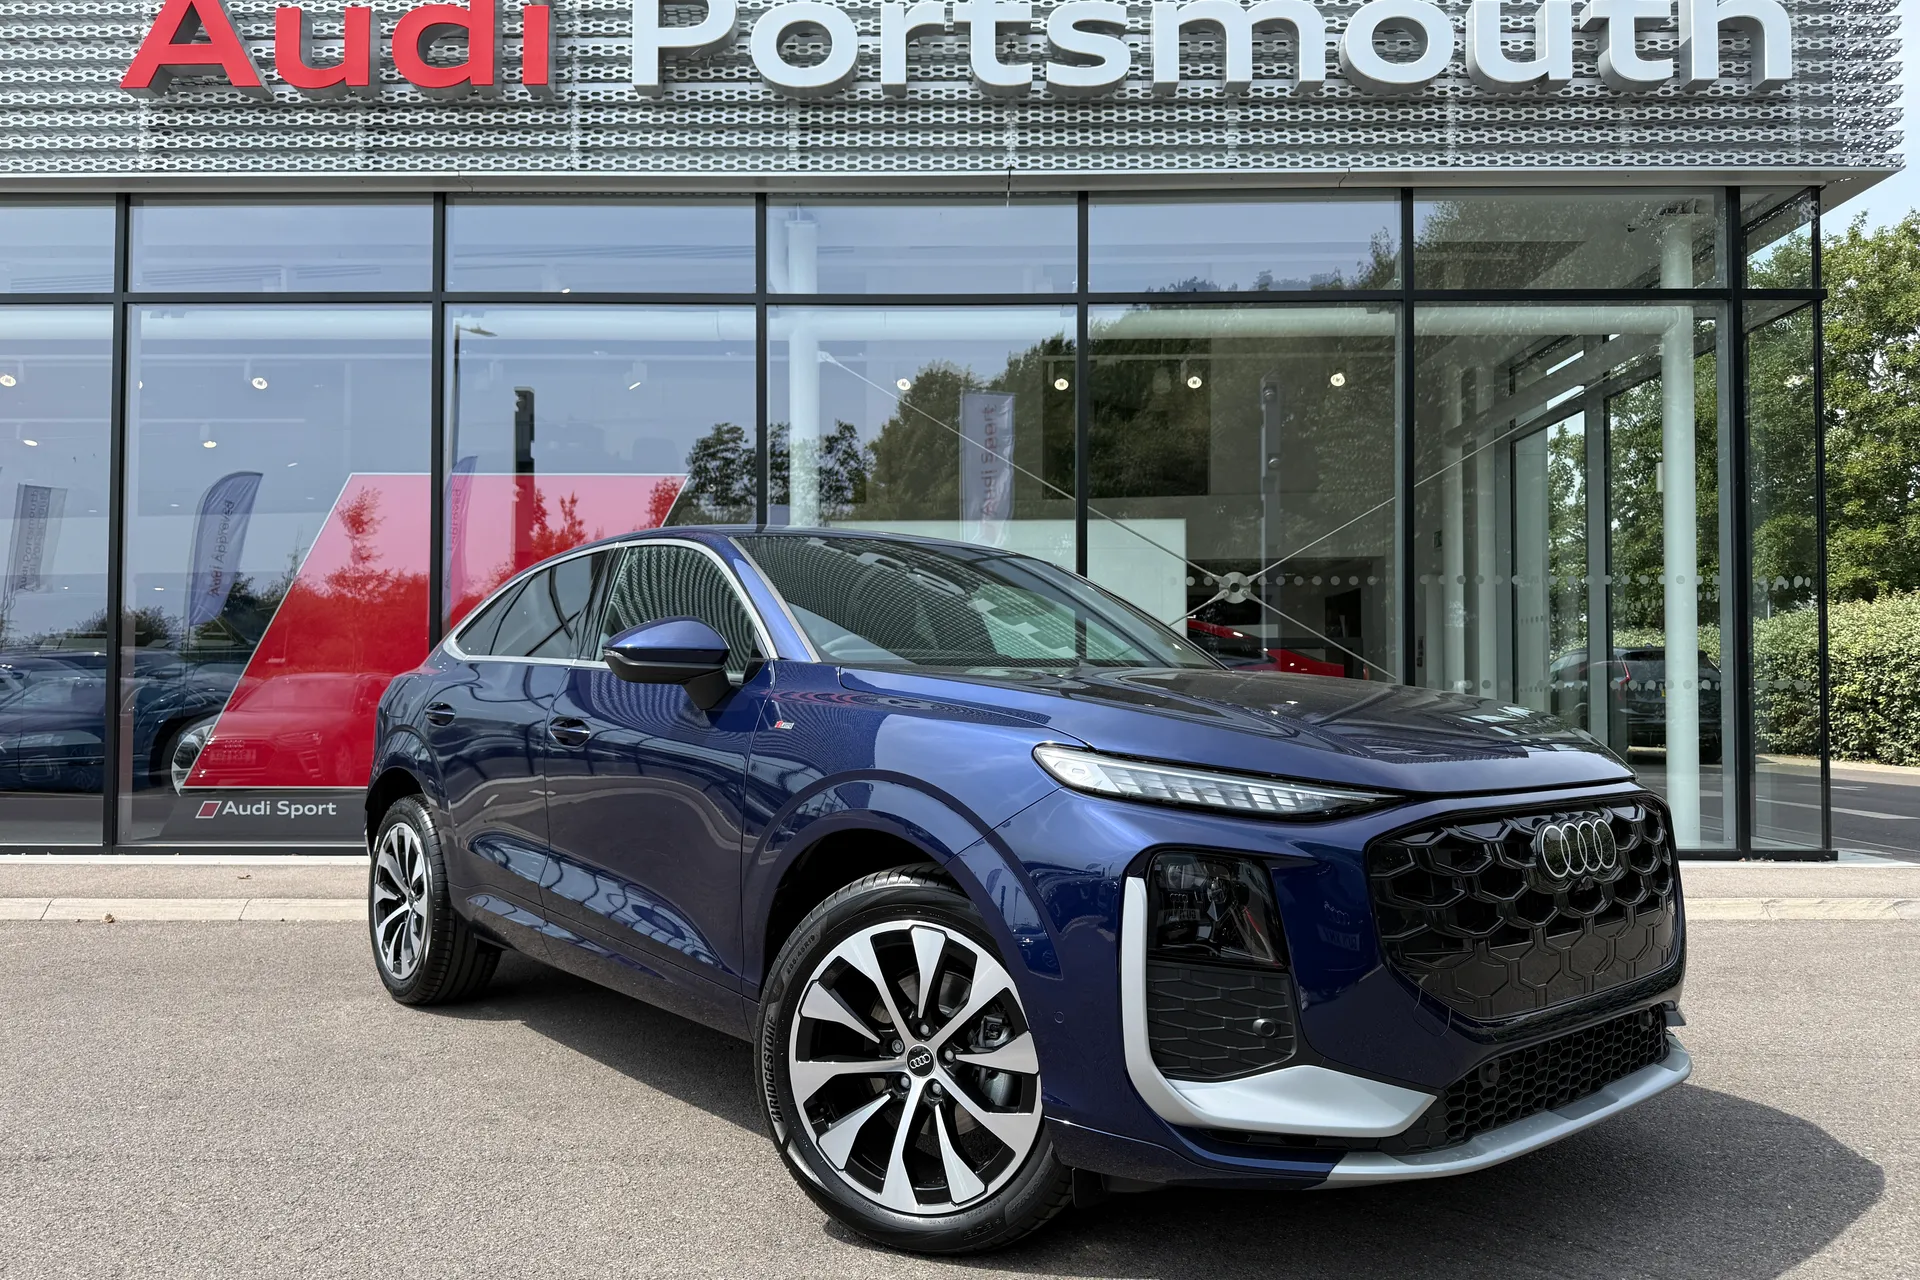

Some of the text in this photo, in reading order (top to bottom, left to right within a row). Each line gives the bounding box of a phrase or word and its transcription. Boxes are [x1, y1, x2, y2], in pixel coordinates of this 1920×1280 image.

[120, 0, 1793, 89] Audi Portsmouth
[222, 800, 337, 819] Audi Sport
[762, 1013, 784, 1123] BRIDGESTONE
